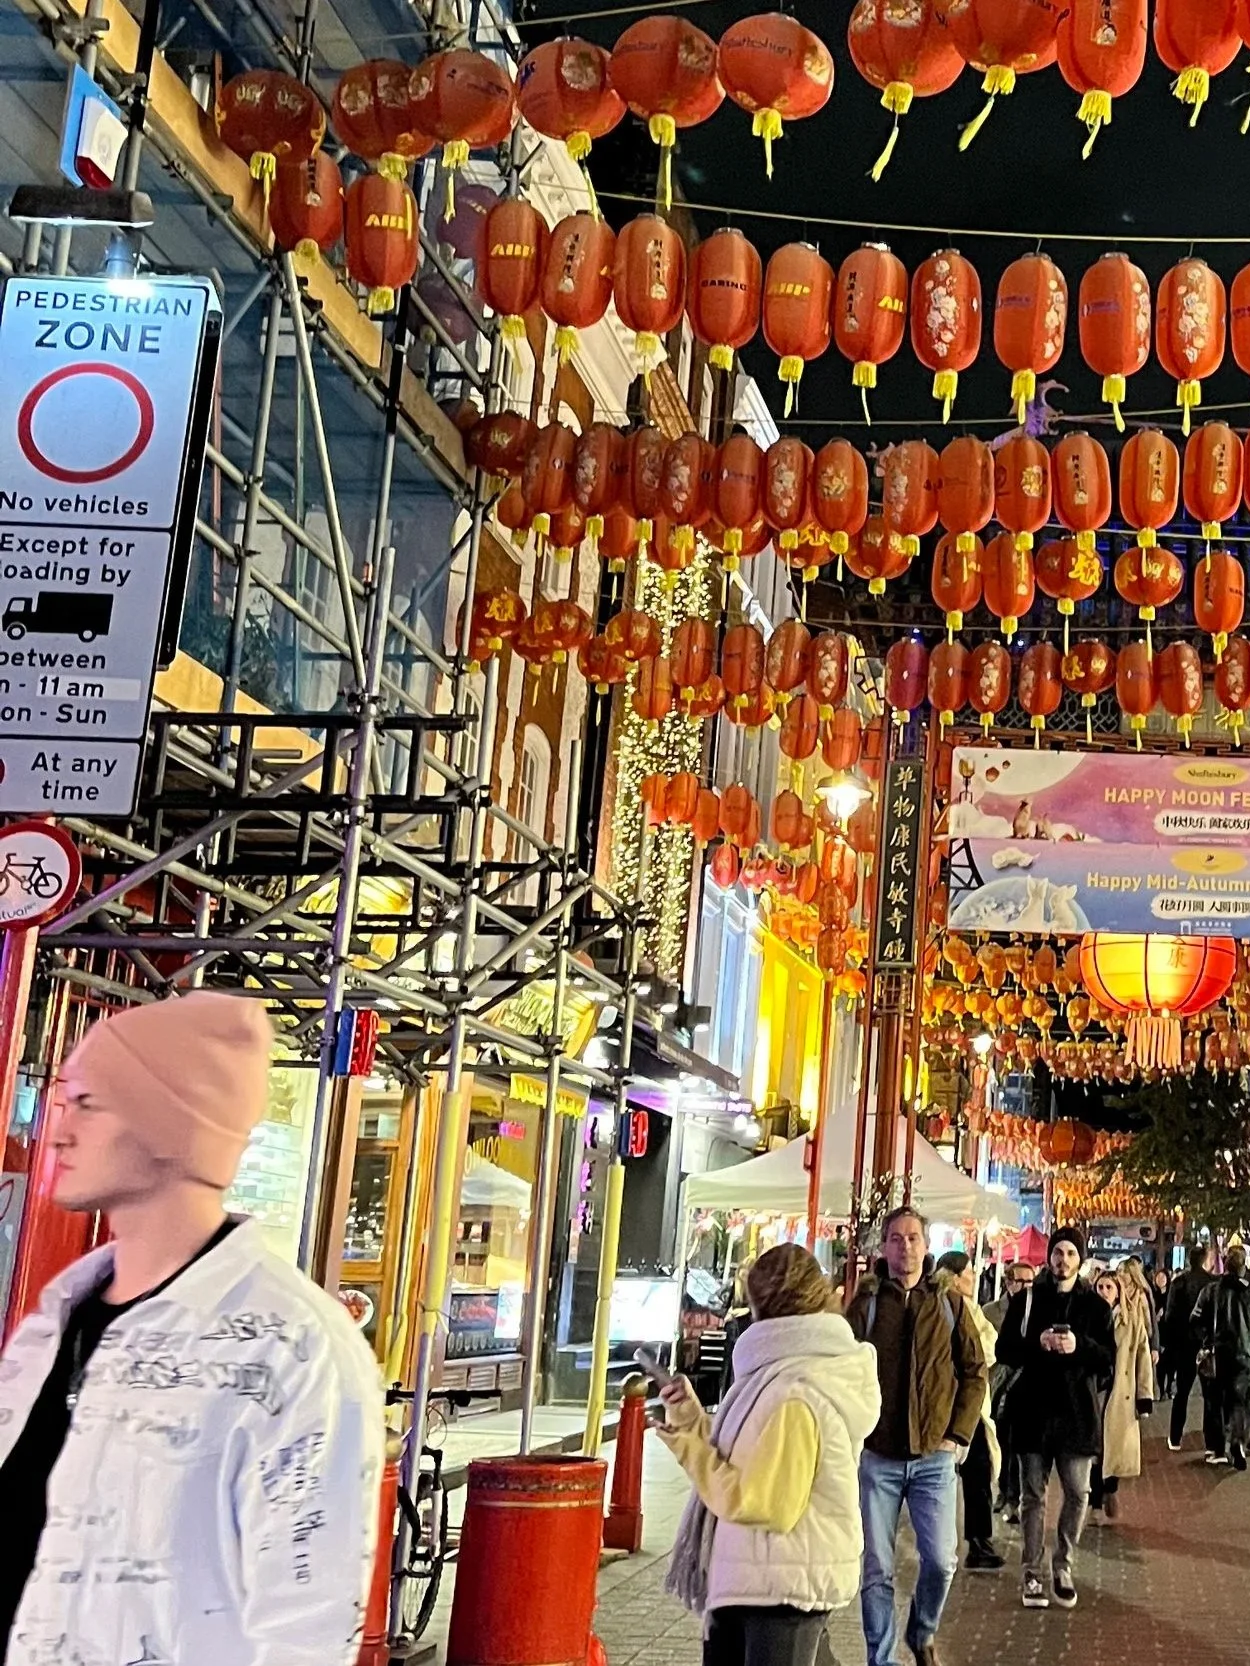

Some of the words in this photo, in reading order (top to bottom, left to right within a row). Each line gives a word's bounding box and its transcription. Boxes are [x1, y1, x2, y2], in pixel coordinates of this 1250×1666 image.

[15, 290, 192, 316] PEDESTRIAN
[35, 319, 162, 354] ZONE
[0, 491, 33, 511] No
[44, 494, 149, 516] vehicles
[0, 533, 88, 558] Except
[98, 537, 136, 558] for
[0, 560, 90, 586] oading
[101, 564, 132, 587] by
[0, 706, 32, 722] on
[56, 703, 107, 724] Sun
[31, 752, 62, 772] At
[71, 758, 118, 777] any
[42, 780, 99, 800] time
[1103, 787, 1165, 805] HAPPY
[1171, 789, 1225, 807] MOON
[1087, 871, 1141, 891] Happy
